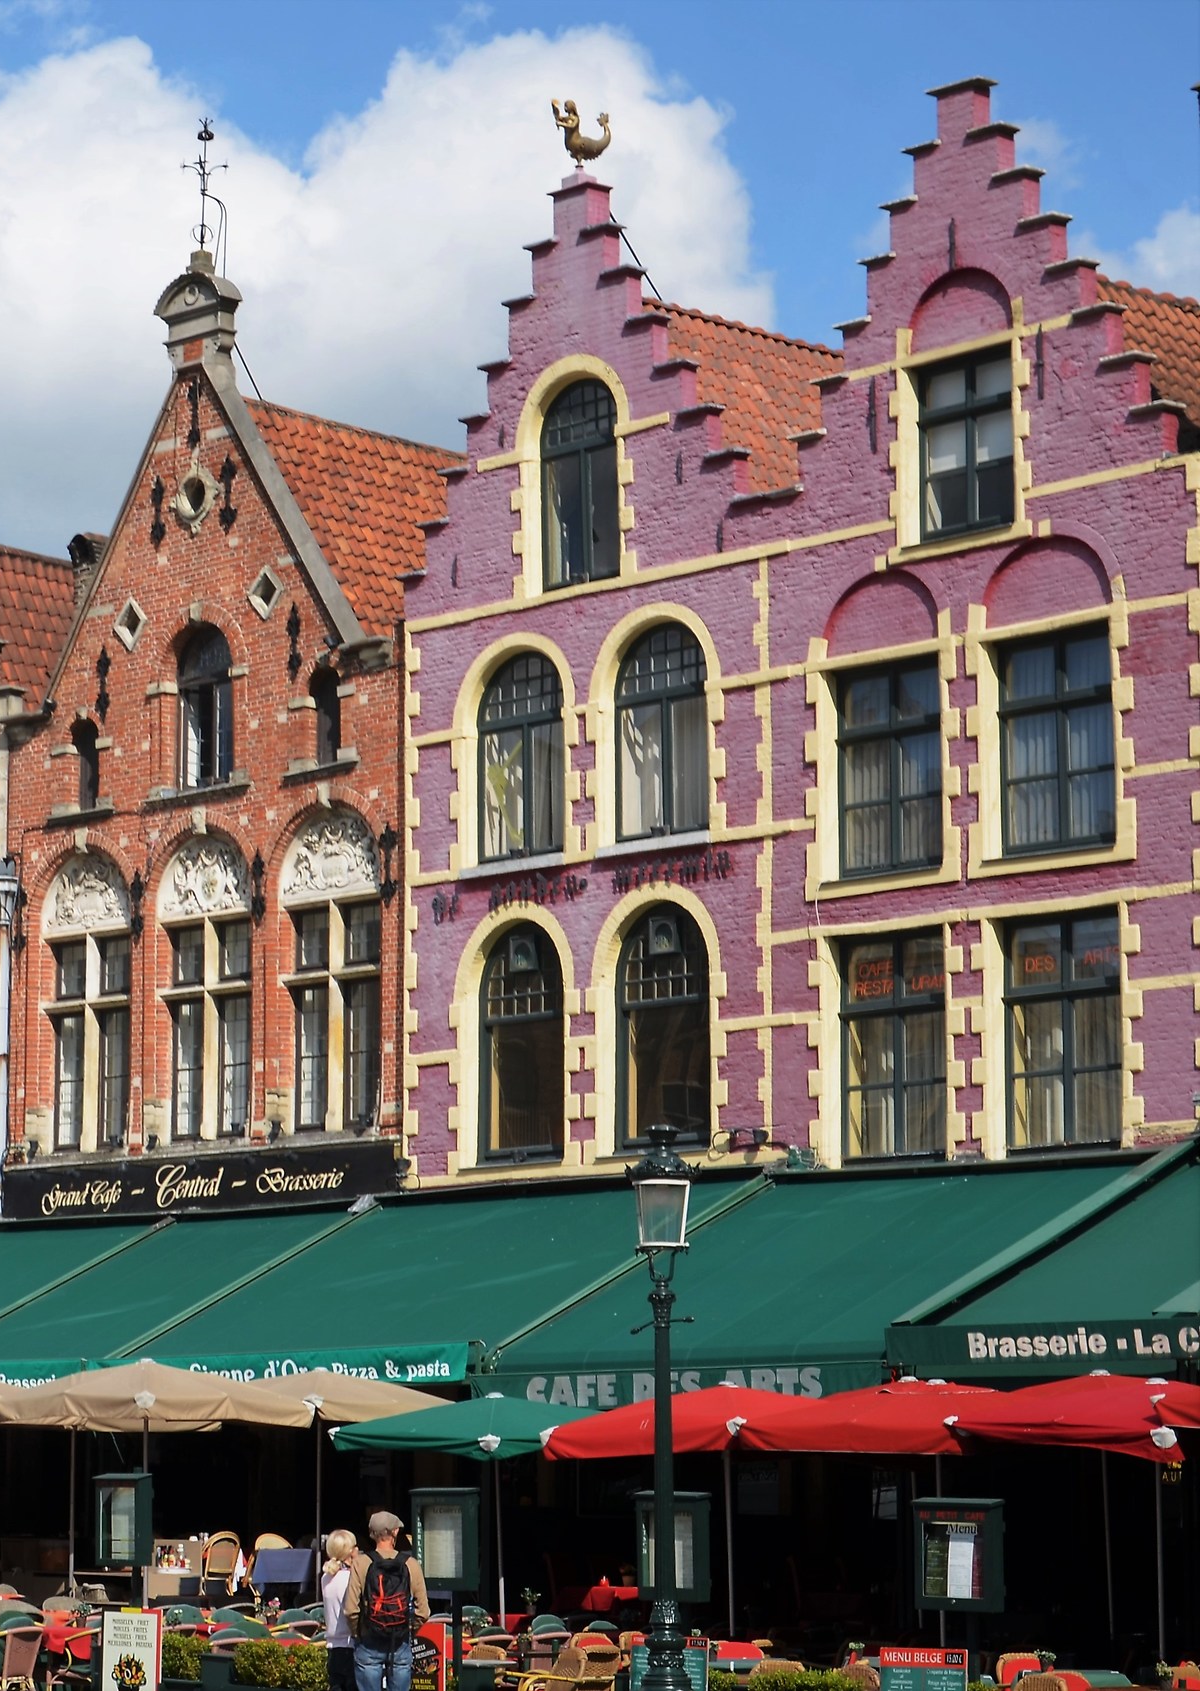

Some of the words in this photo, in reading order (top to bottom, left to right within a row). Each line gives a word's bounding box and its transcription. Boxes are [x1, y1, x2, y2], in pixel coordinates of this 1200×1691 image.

[1024, 955, 1055, 973] DES
[42, 1182, 90, 1215] Grand
[156, 1164, 224, 1208] Central
[256, 1168, 344, 1194] Brasserie
[968, 1326, 1107, 1359] Brasserie
[1134, 1328, 1171, 1354] La
[332, 1362, 379, 1380] Pizza
[385, 1360, 401, 1378] &
[406, 1359, 450, 1381] pasta
[526, 1374, 618, 1407] CAFE
[947, 1524, 977, 1535] Menu
[884, 1652, 911, 1662] MENU
[914, 1652, 942, 1663] BELGE
